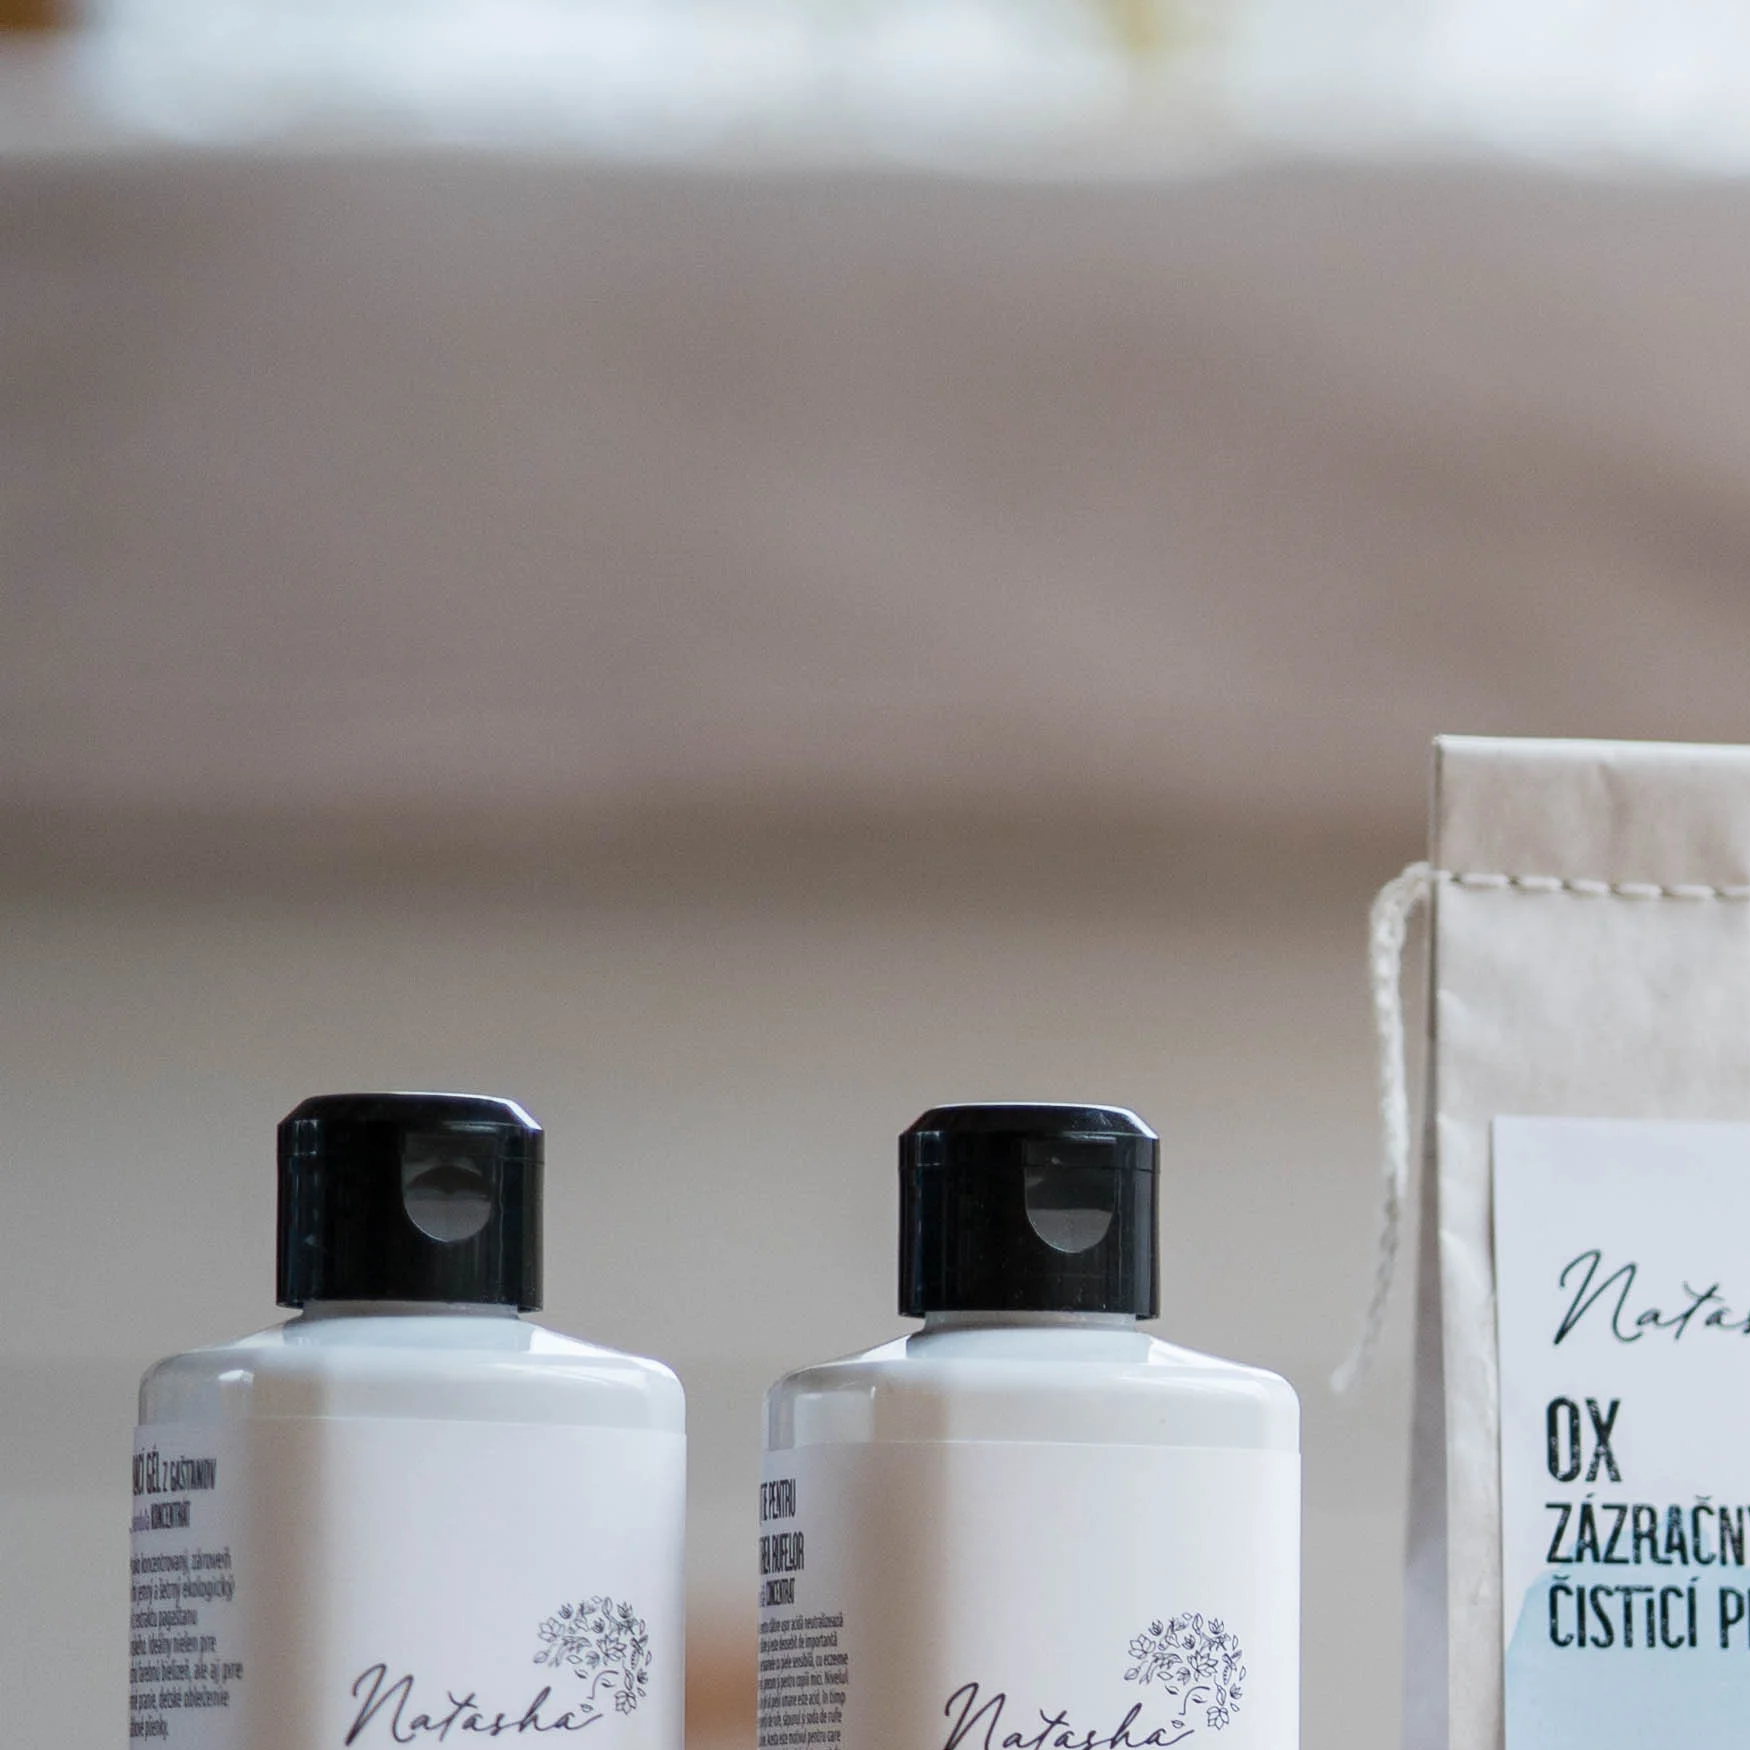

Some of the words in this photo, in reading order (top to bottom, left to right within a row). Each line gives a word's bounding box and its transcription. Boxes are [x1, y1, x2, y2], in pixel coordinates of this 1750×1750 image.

[1546, 1397, 1621, 1482] OX
[769, 1479, 796, 1520] PENTRU
[772, 1532, 804, 1573] RUFELOR
[344, 1662, 603, 1747] Natasha
